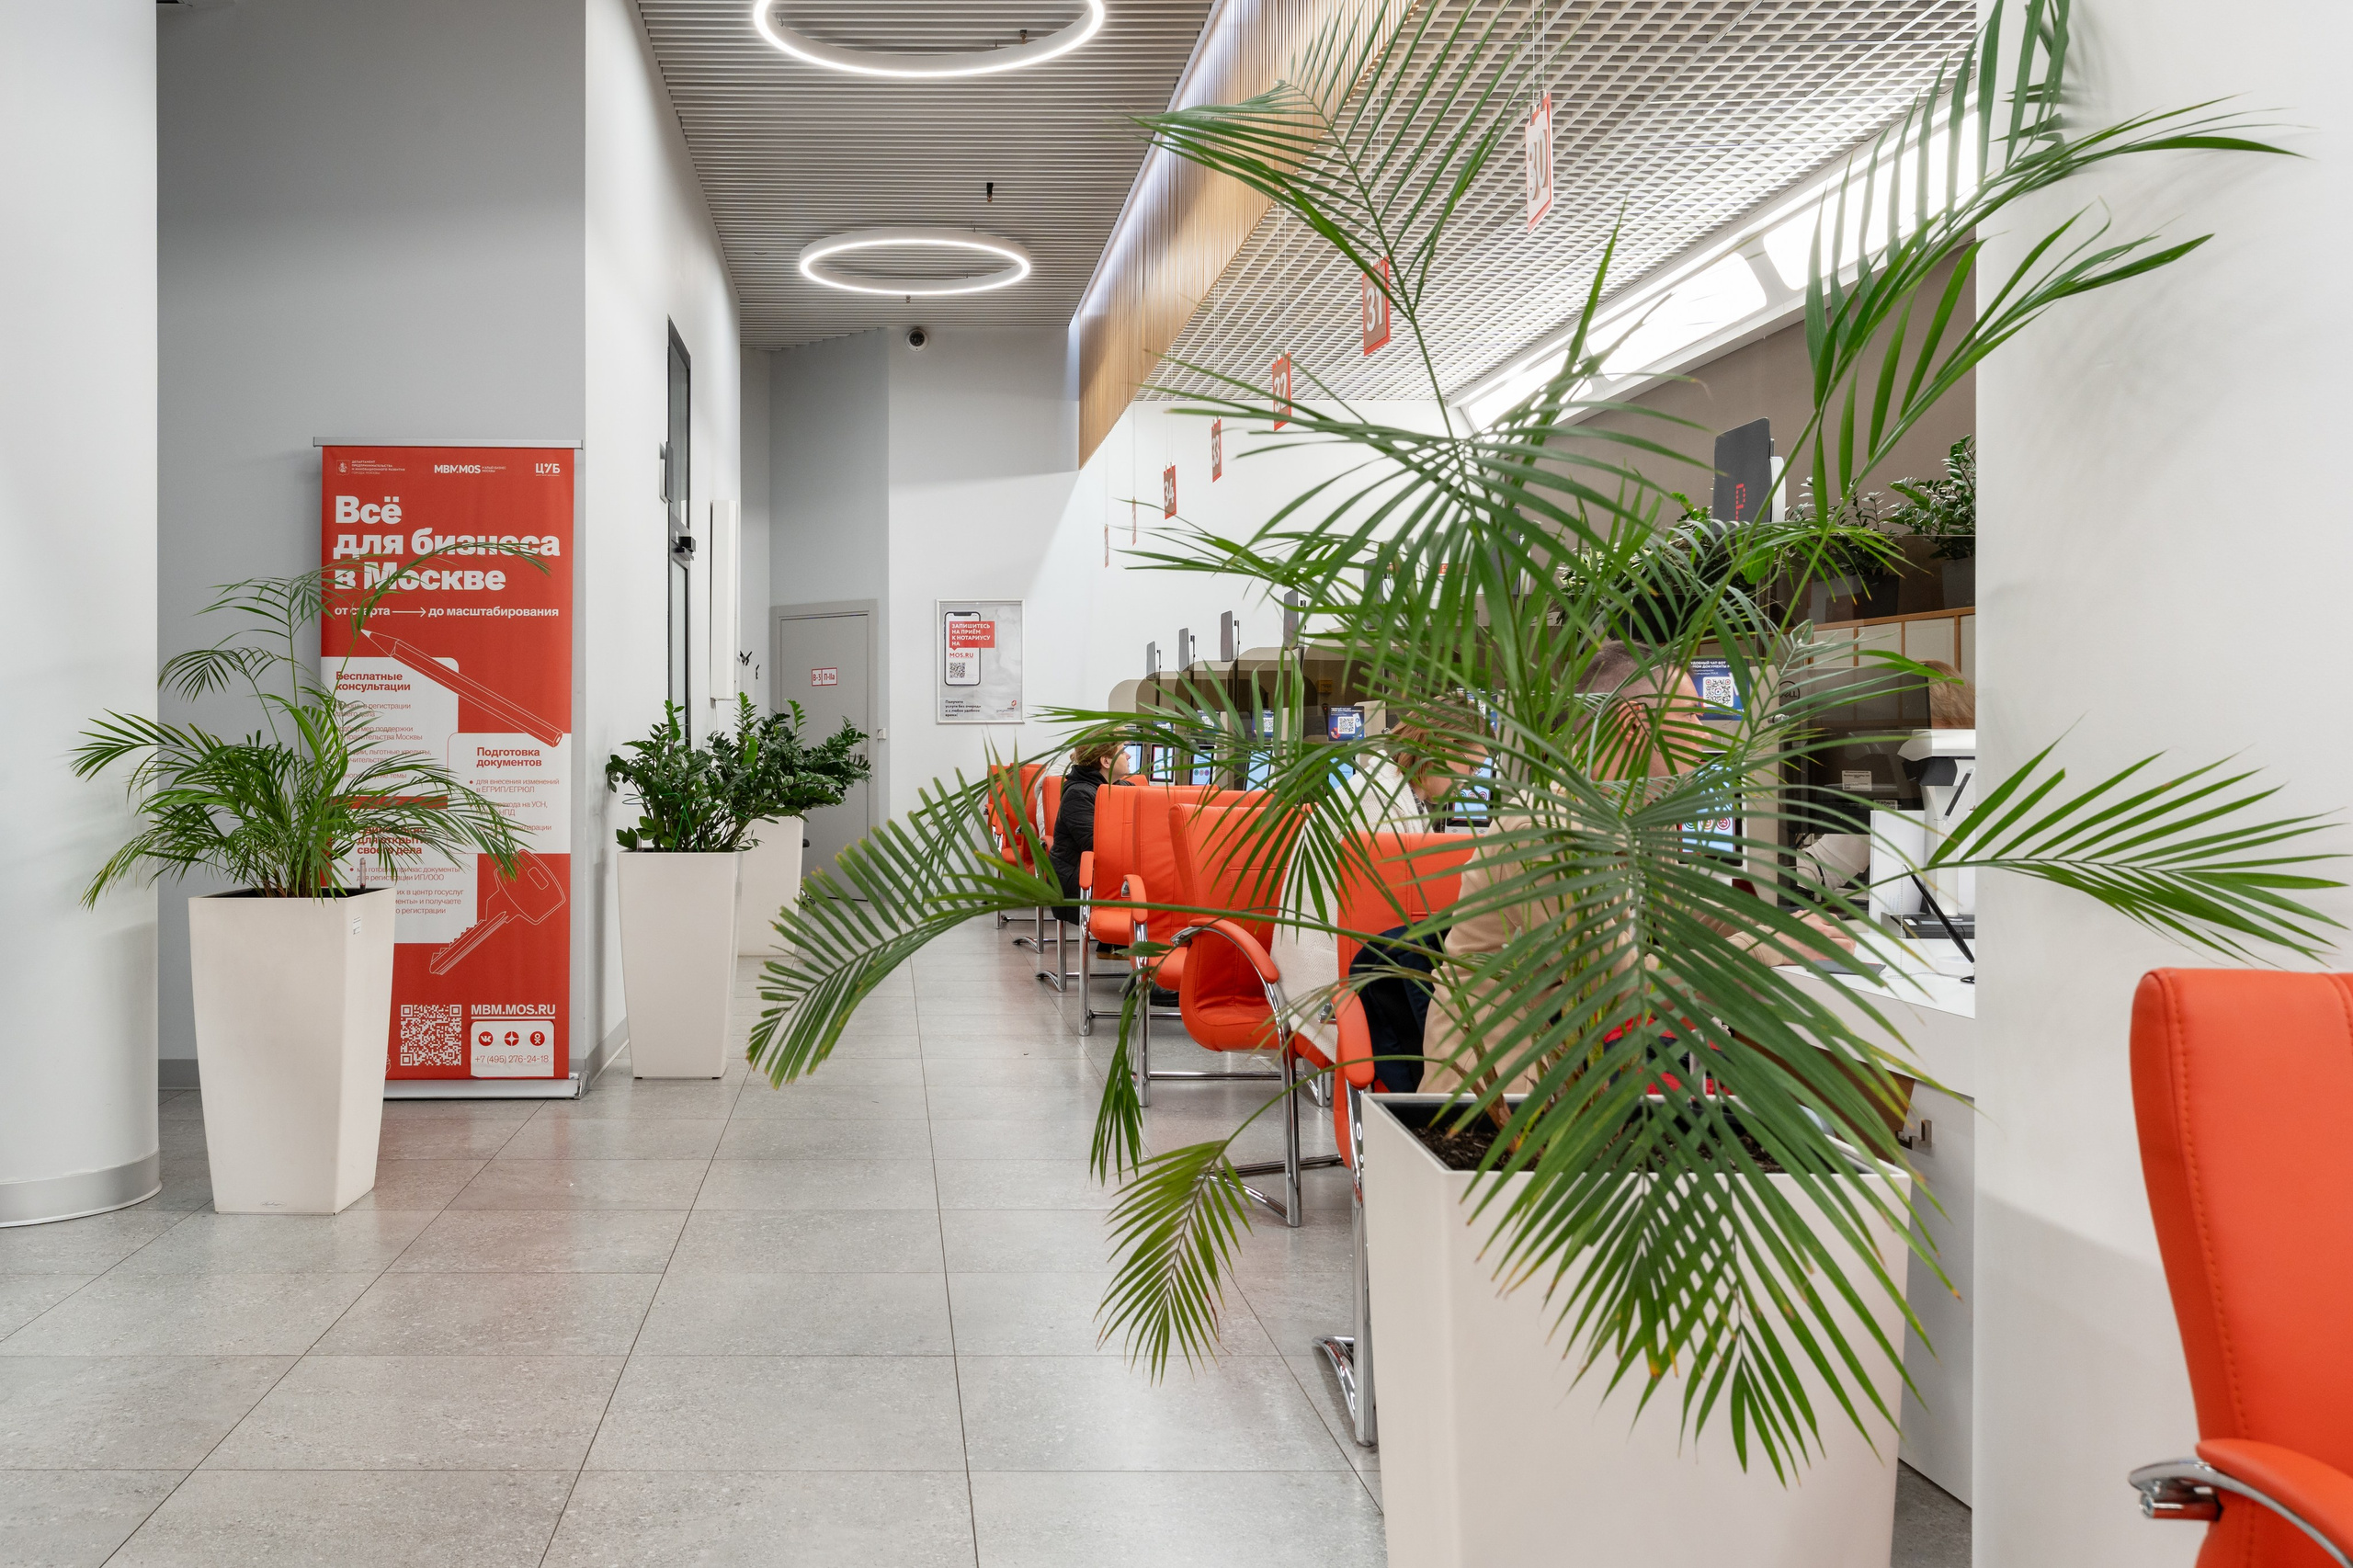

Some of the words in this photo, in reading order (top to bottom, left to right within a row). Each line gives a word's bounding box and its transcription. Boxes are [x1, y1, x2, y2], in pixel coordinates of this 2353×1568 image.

[1528, 129, 1548, 201] 30
[1366, 287, 1382, 332] 31
[1274, 371, 1288, 413] 32
[1211, 434, 1221, 468] 33
[1164, 478, 1175, 507] 34
[335, 494, 402, 524] Всё
[333, 534, 404, 560] для
[411, 528, 561, 557] бизнеса
[335, 570, 357, 590] в
[364, 562, 506, 591] Москве
[335, 608, 348, 616] от
[350, 608, 391, 617] сарта
[428, 608, 444, 617] до
[447, 606, 559, 617] масштабирования
[336, 671, 403, 680] Бесплатные
[336, 683, 411, 693] консультации
[476, 746, 540, 757] Подготовка
[476, 759, 542, 768] документов
[380, 837, 431, 846] открыт
[402, 907, 447, 915] регистрации
[471, 1004, 556, 1016] MBM.MOS.RU
[486, 1054, 507, 1065] (495)
[508, 1054, 549, 1063] 276-24-18
